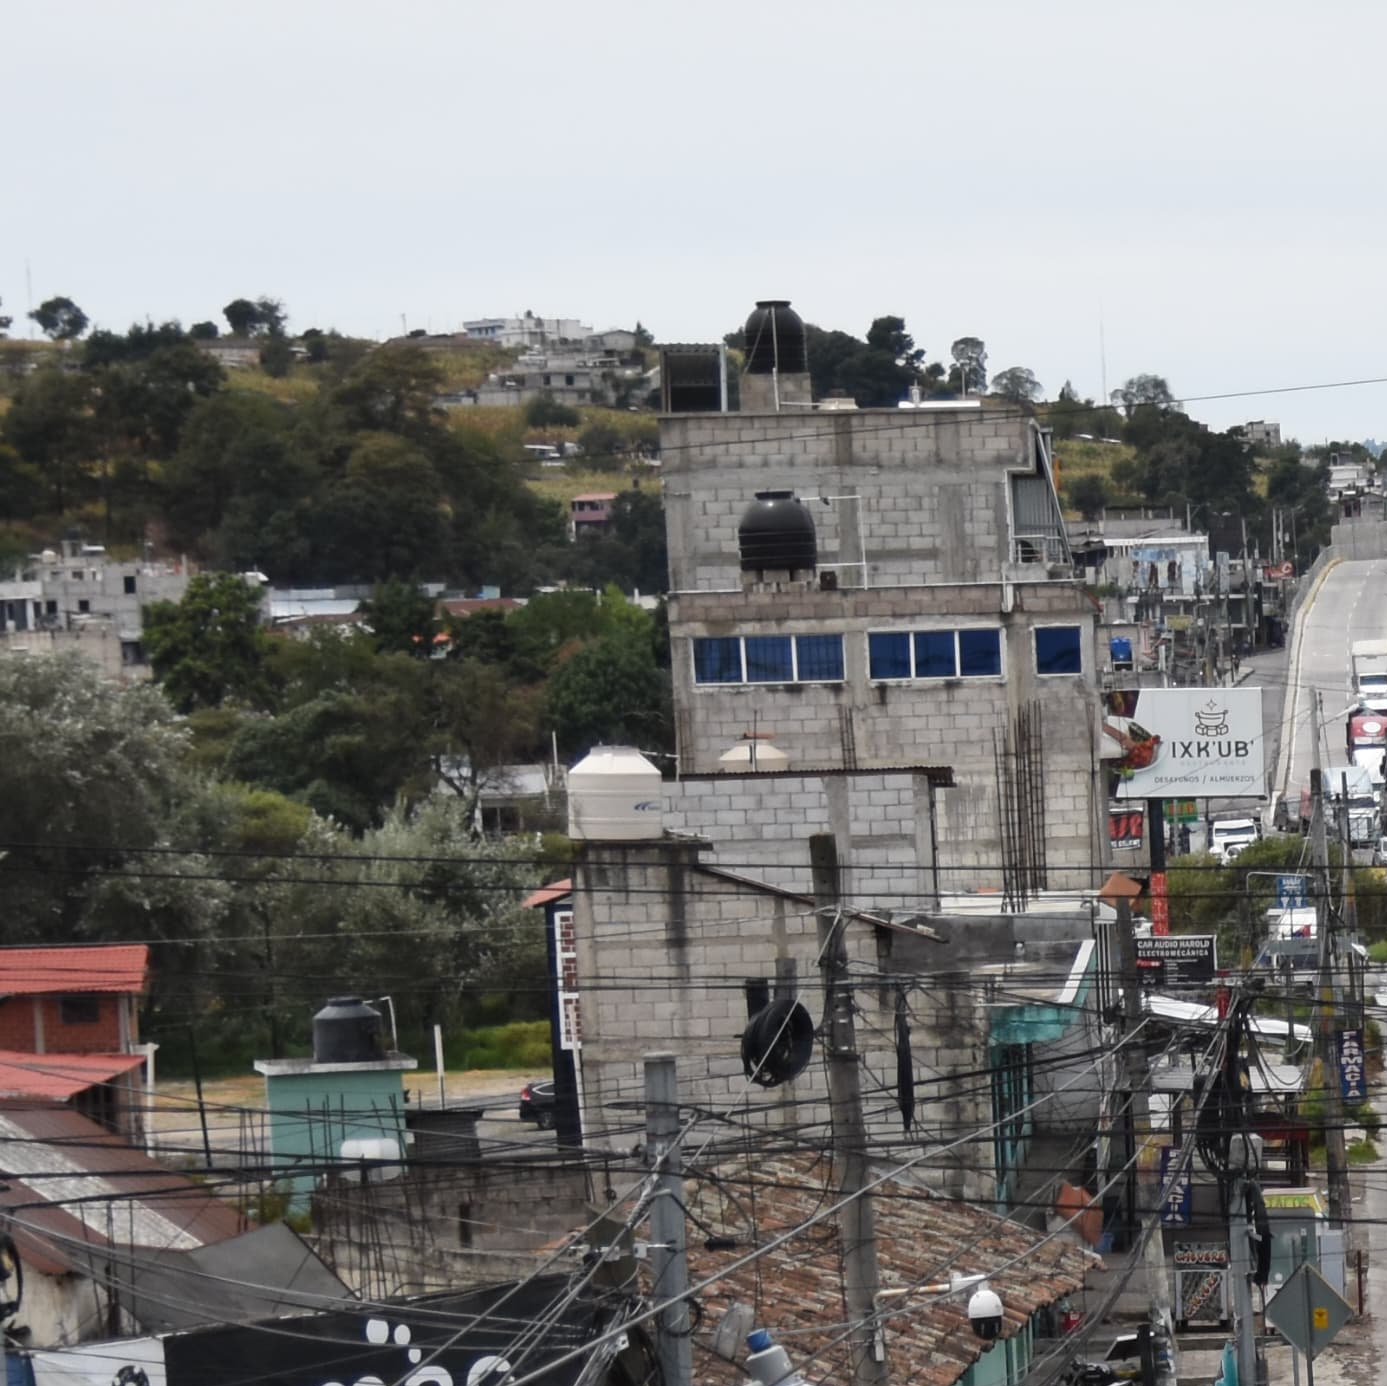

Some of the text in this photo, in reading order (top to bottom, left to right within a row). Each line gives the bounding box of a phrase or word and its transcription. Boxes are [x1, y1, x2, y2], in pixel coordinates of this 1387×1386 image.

[1137, 939, 1210, 949] CAR AUDIO HAROLD
